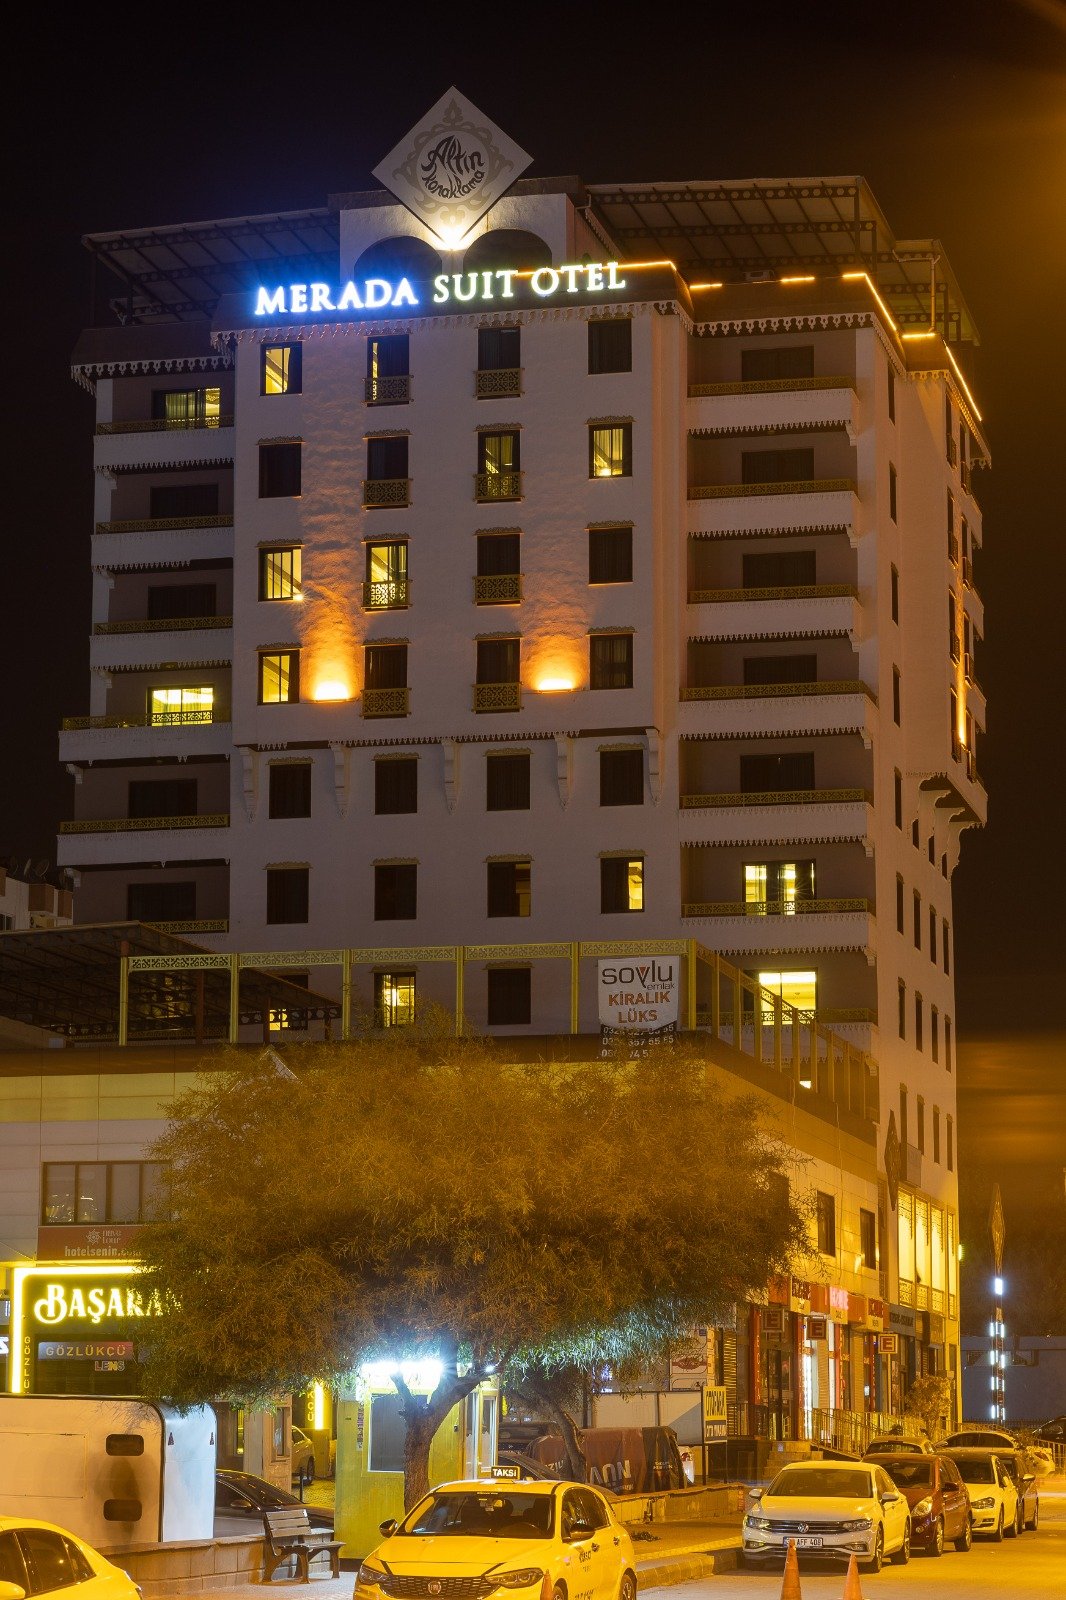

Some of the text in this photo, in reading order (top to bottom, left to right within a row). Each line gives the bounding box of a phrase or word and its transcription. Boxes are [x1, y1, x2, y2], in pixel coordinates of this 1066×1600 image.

[254, 262, 627, 315] MERADA SUIT OTEL
[647, 982, 675, 990] emlak
[608, 991, 671, 1006] KİRALIK
[618, 1008, 658, 1024] LÜKS
[45, 1346, 126, 1357] GÖZLÜKÇÜ
[94, 1360, 126, 1372] LENS
